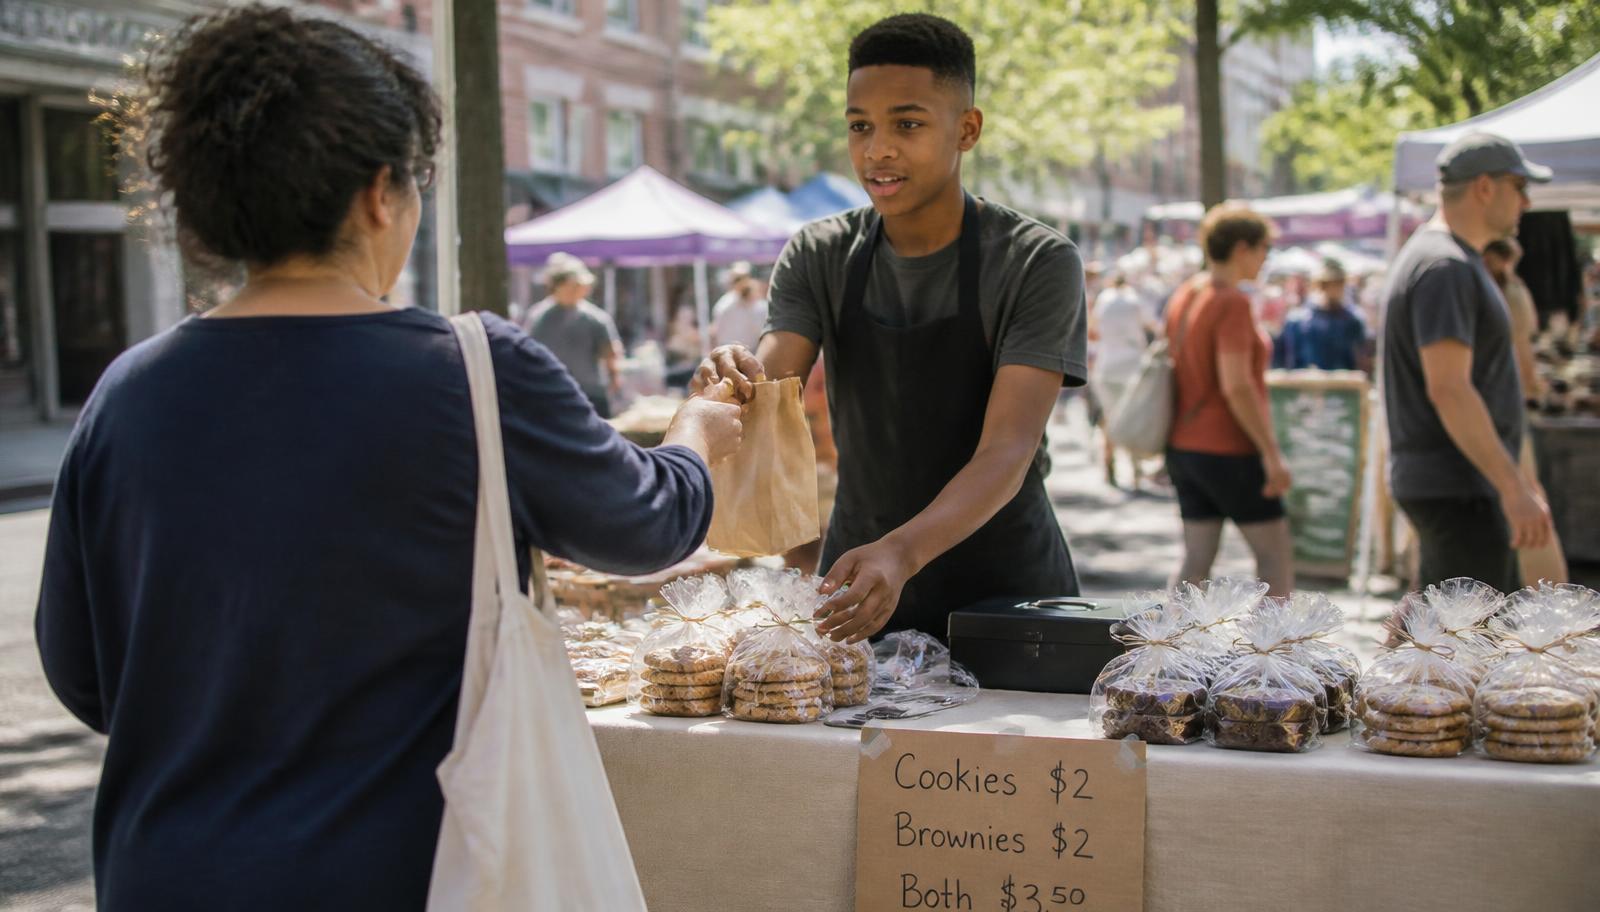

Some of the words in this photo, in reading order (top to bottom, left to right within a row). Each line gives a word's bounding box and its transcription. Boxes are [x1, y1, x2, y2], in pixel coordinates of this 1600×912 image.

[894, 752, 1017, 796] Cookies
[1049, 759, 1094, 804] $2
[894, 810, 1026, 854] Brownies
[1051, 821, 1094, 860] $2
[900, 873, 972, 911] Both
